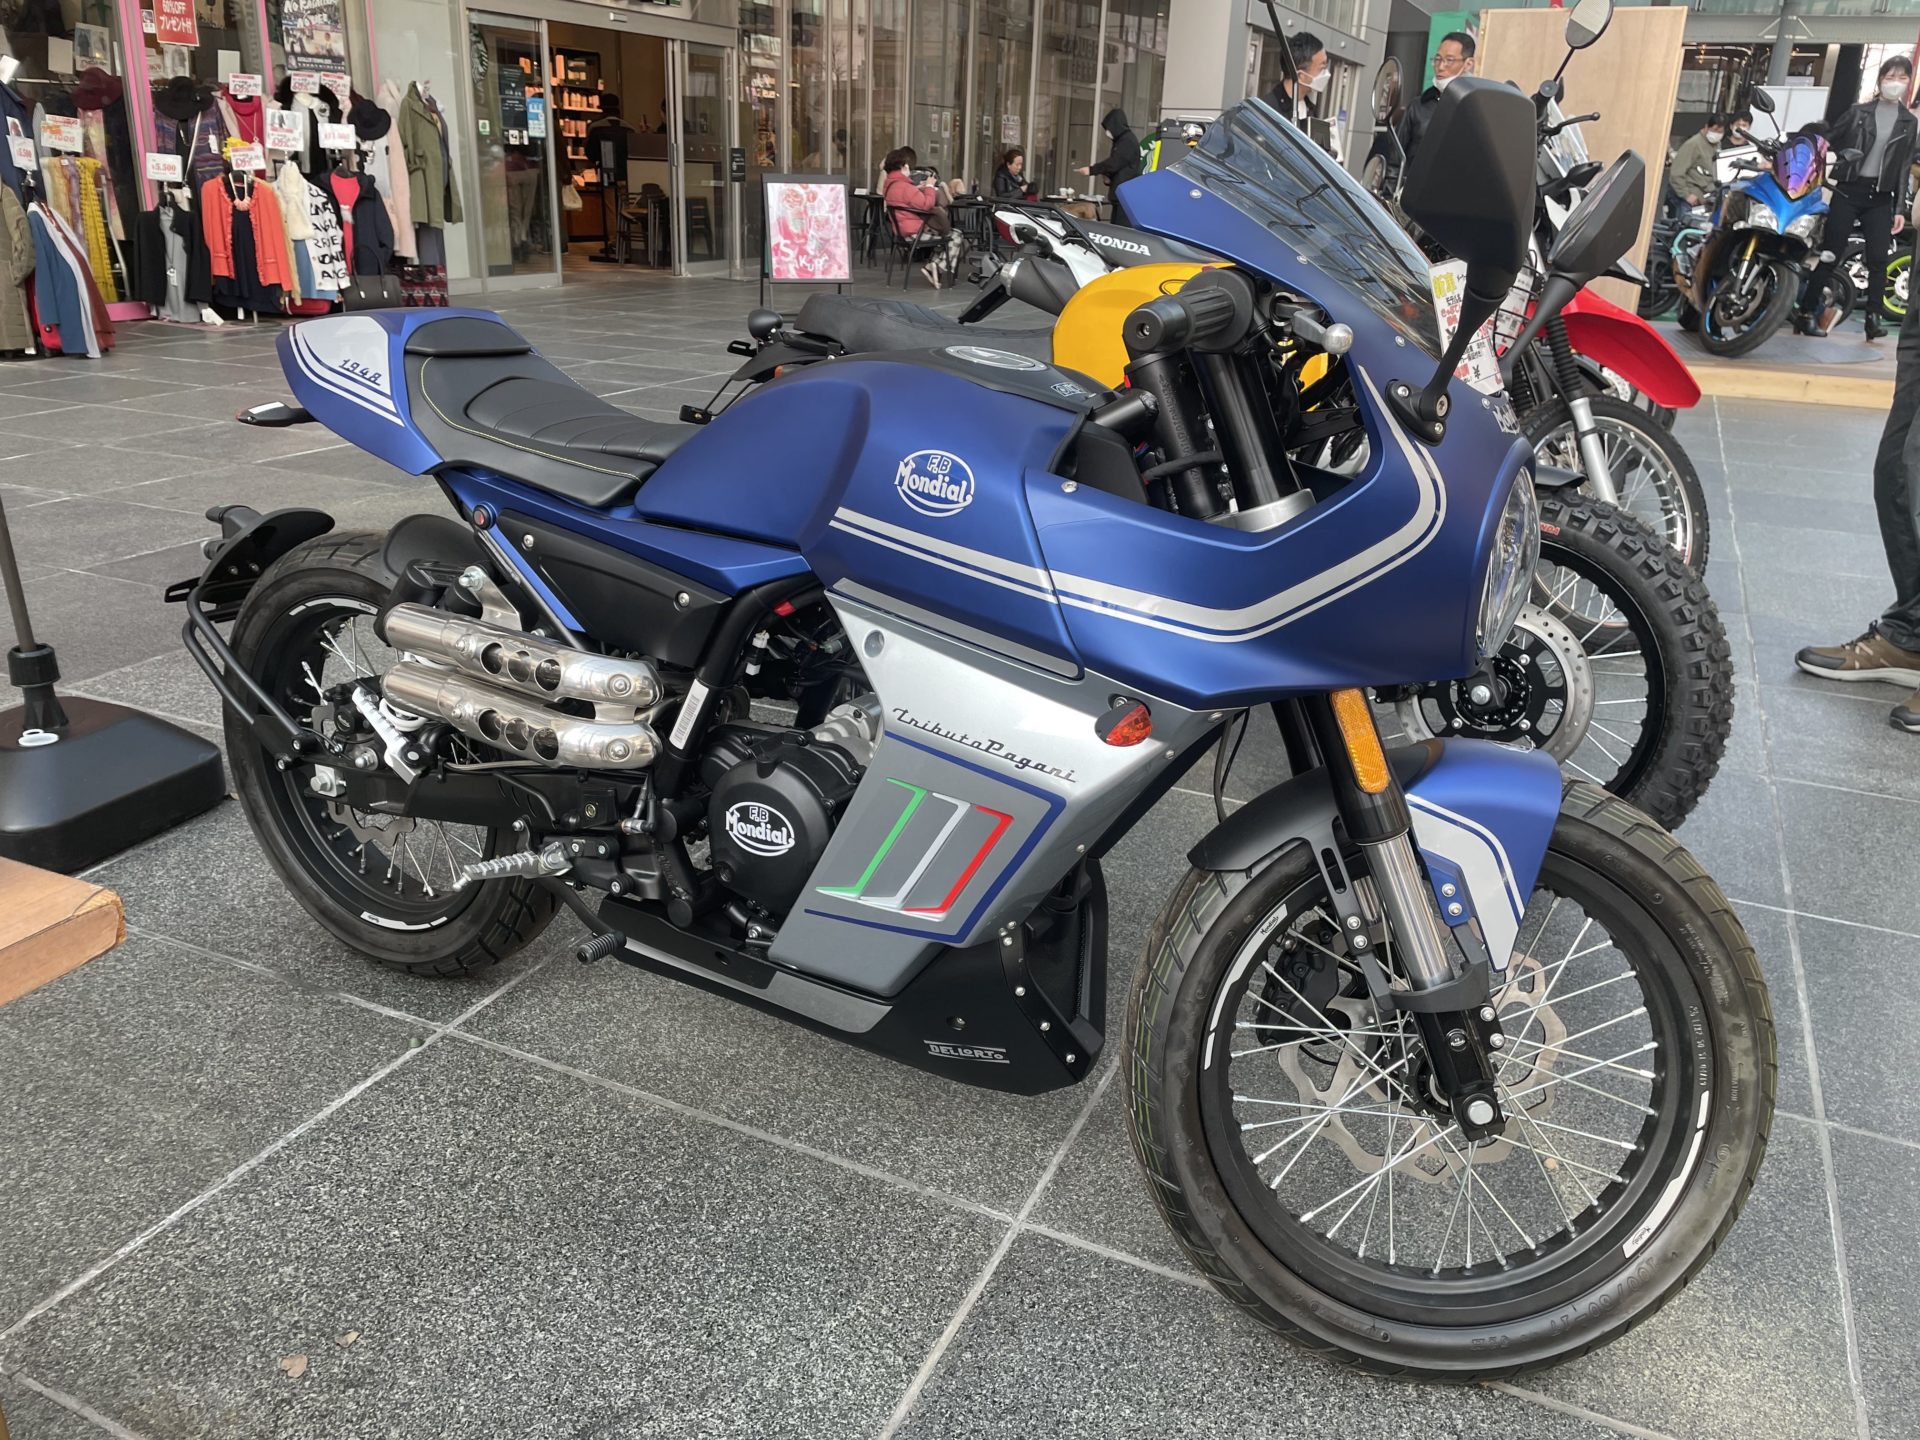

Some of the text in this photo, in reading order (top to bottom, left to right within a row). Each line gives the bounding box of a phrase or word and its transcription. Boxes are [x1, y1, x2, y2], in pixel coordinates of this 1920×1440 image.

[1088, 232, 1151, 257] HONDA
[339, 358, 382, 387] 1948
[894, 459, 967, 503] Mondial
[725, 808, 788, 846] Mondial
